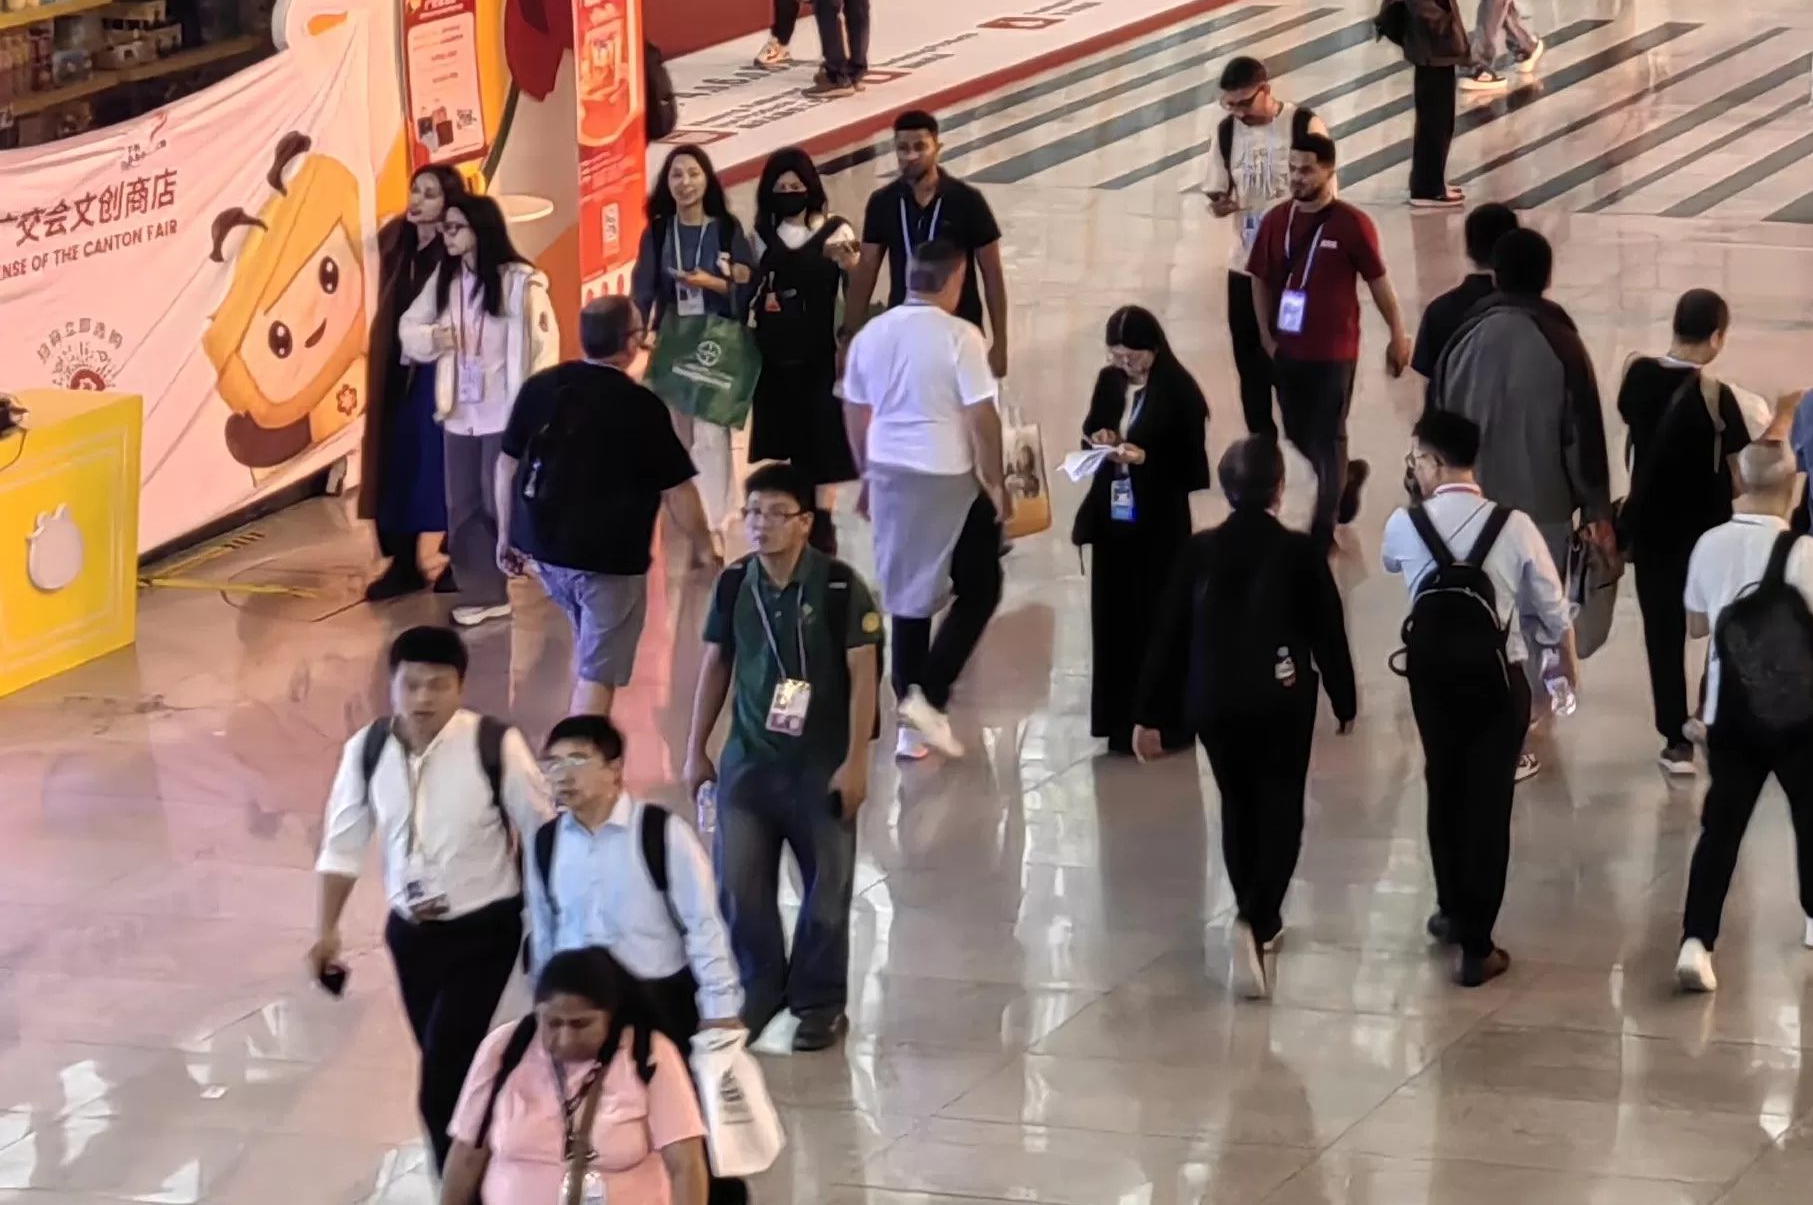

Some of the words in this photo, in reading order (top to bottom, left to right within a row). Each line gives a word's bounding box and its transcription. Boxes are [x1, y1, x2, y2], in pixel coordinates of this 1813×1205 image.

[0, 258, 28, 280] NSE
[31, 252, 49, 272] OF
[52, 244, 79, 266] THE
[83, 227, 144, 258] CANTON
[147, 219, 178, 241] FAIR
